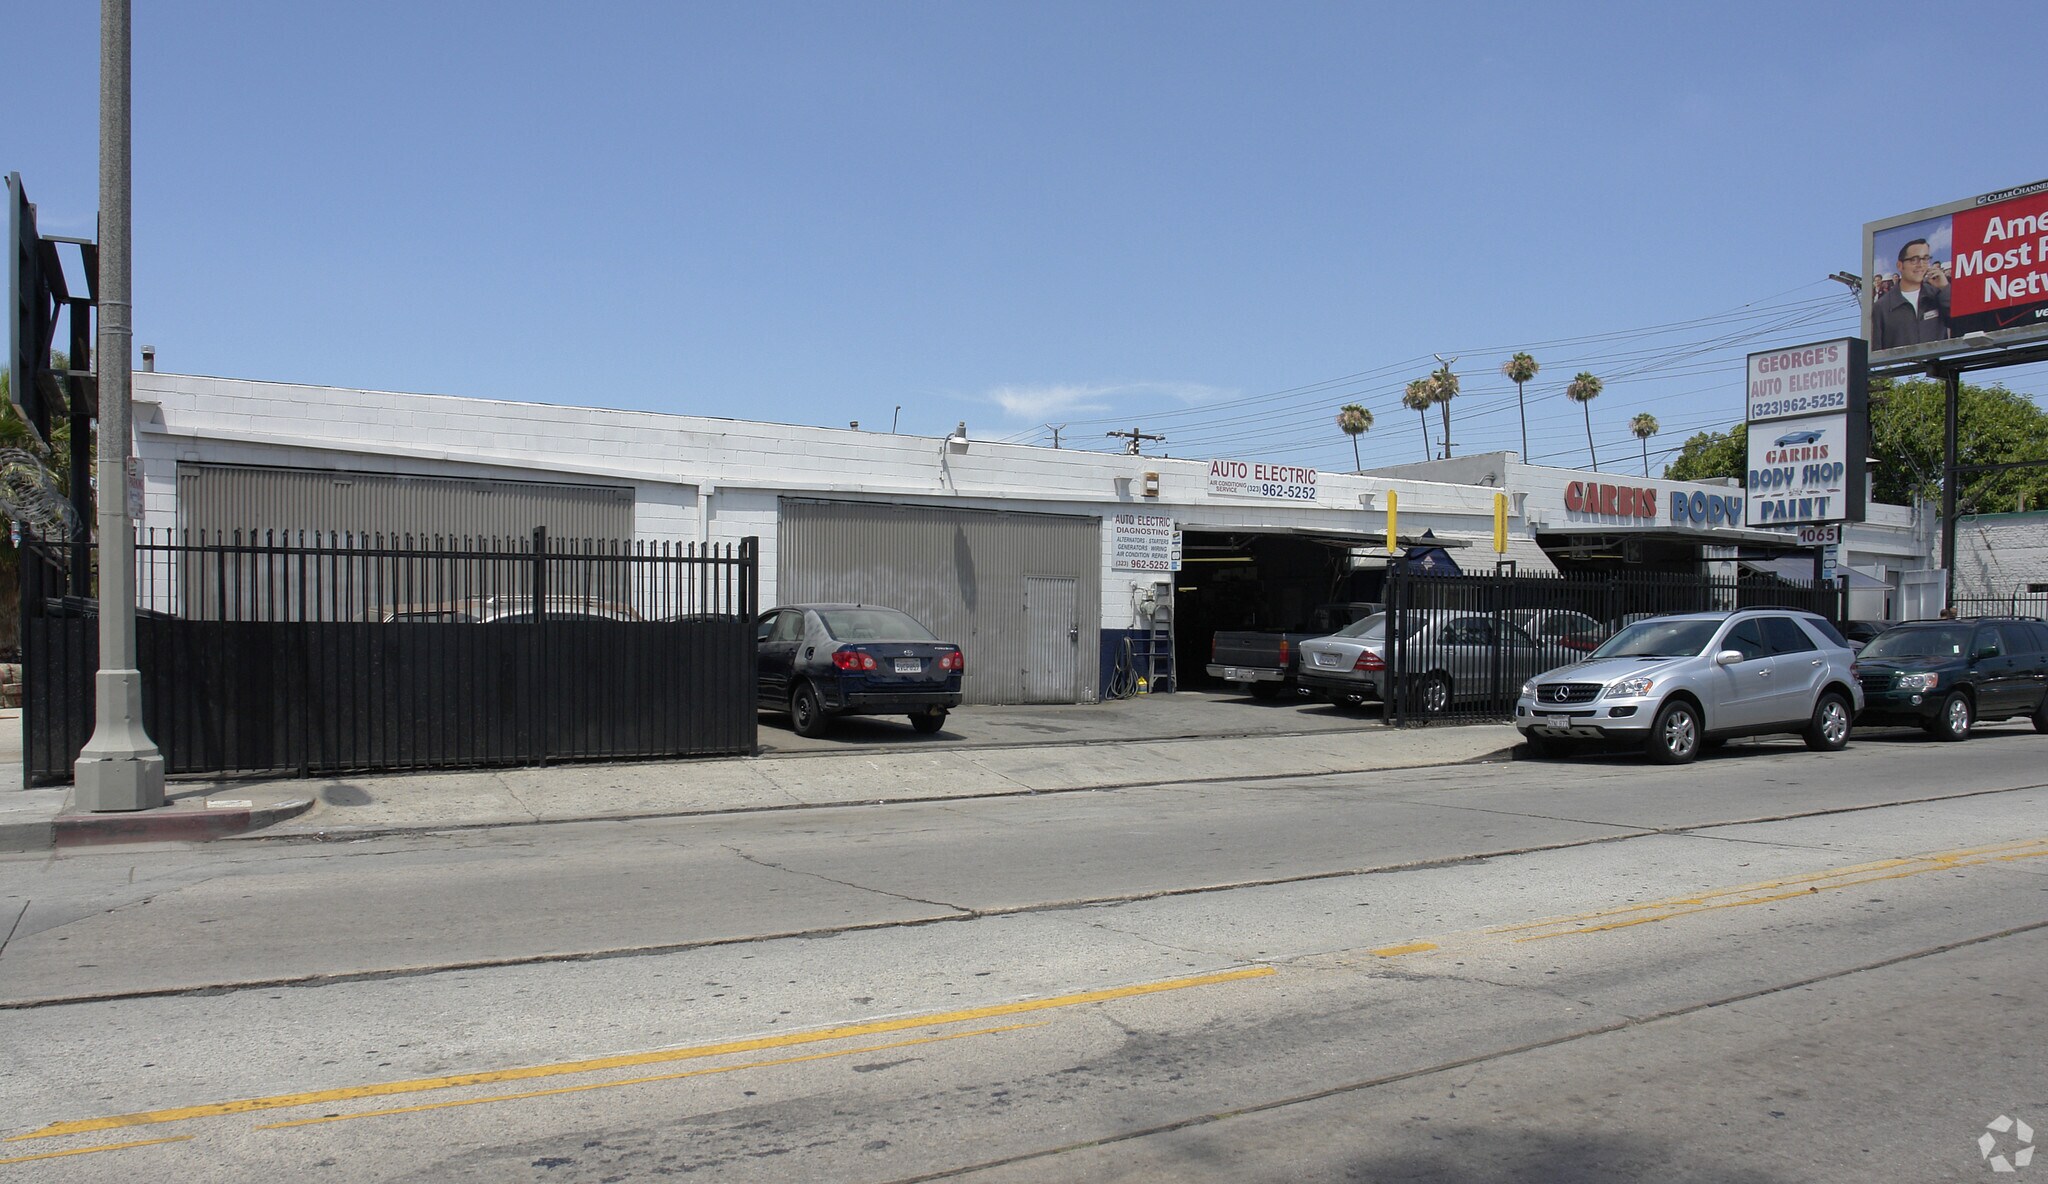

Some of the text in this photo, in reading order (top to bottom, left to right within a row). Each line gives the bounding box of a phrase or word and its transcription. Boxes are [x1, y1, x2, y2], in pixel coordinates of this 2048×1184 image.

[1955, 243, 2032, 279] Most
[1758, 345, 1839, 374] GEORGE'S
[1751, 366, 1846, 399] AUTO ELECTRIC
[1210, 460, 1316, 485] AUTO ELECTRIC
[1750, 461, 1844, 490] BODY SHOP
[1246, 483, 1316, 500] (323) 962-5252
[1670, 490, 1742, 525] BODY
[1760, 496, 1831, 521] PAINT
[1115, 514, 1171, 528] AUTO ELECTRIC
[1116, 526, 1170, 536] DIAGNOSTING
[1116, 536, 1146, 544] ALTERNATORS
[1800, 528, 1835, 543] 1065
[1117, 543, 1148, 551] GENERATORS
[1130, 559, 1169, 570] 962-5252
